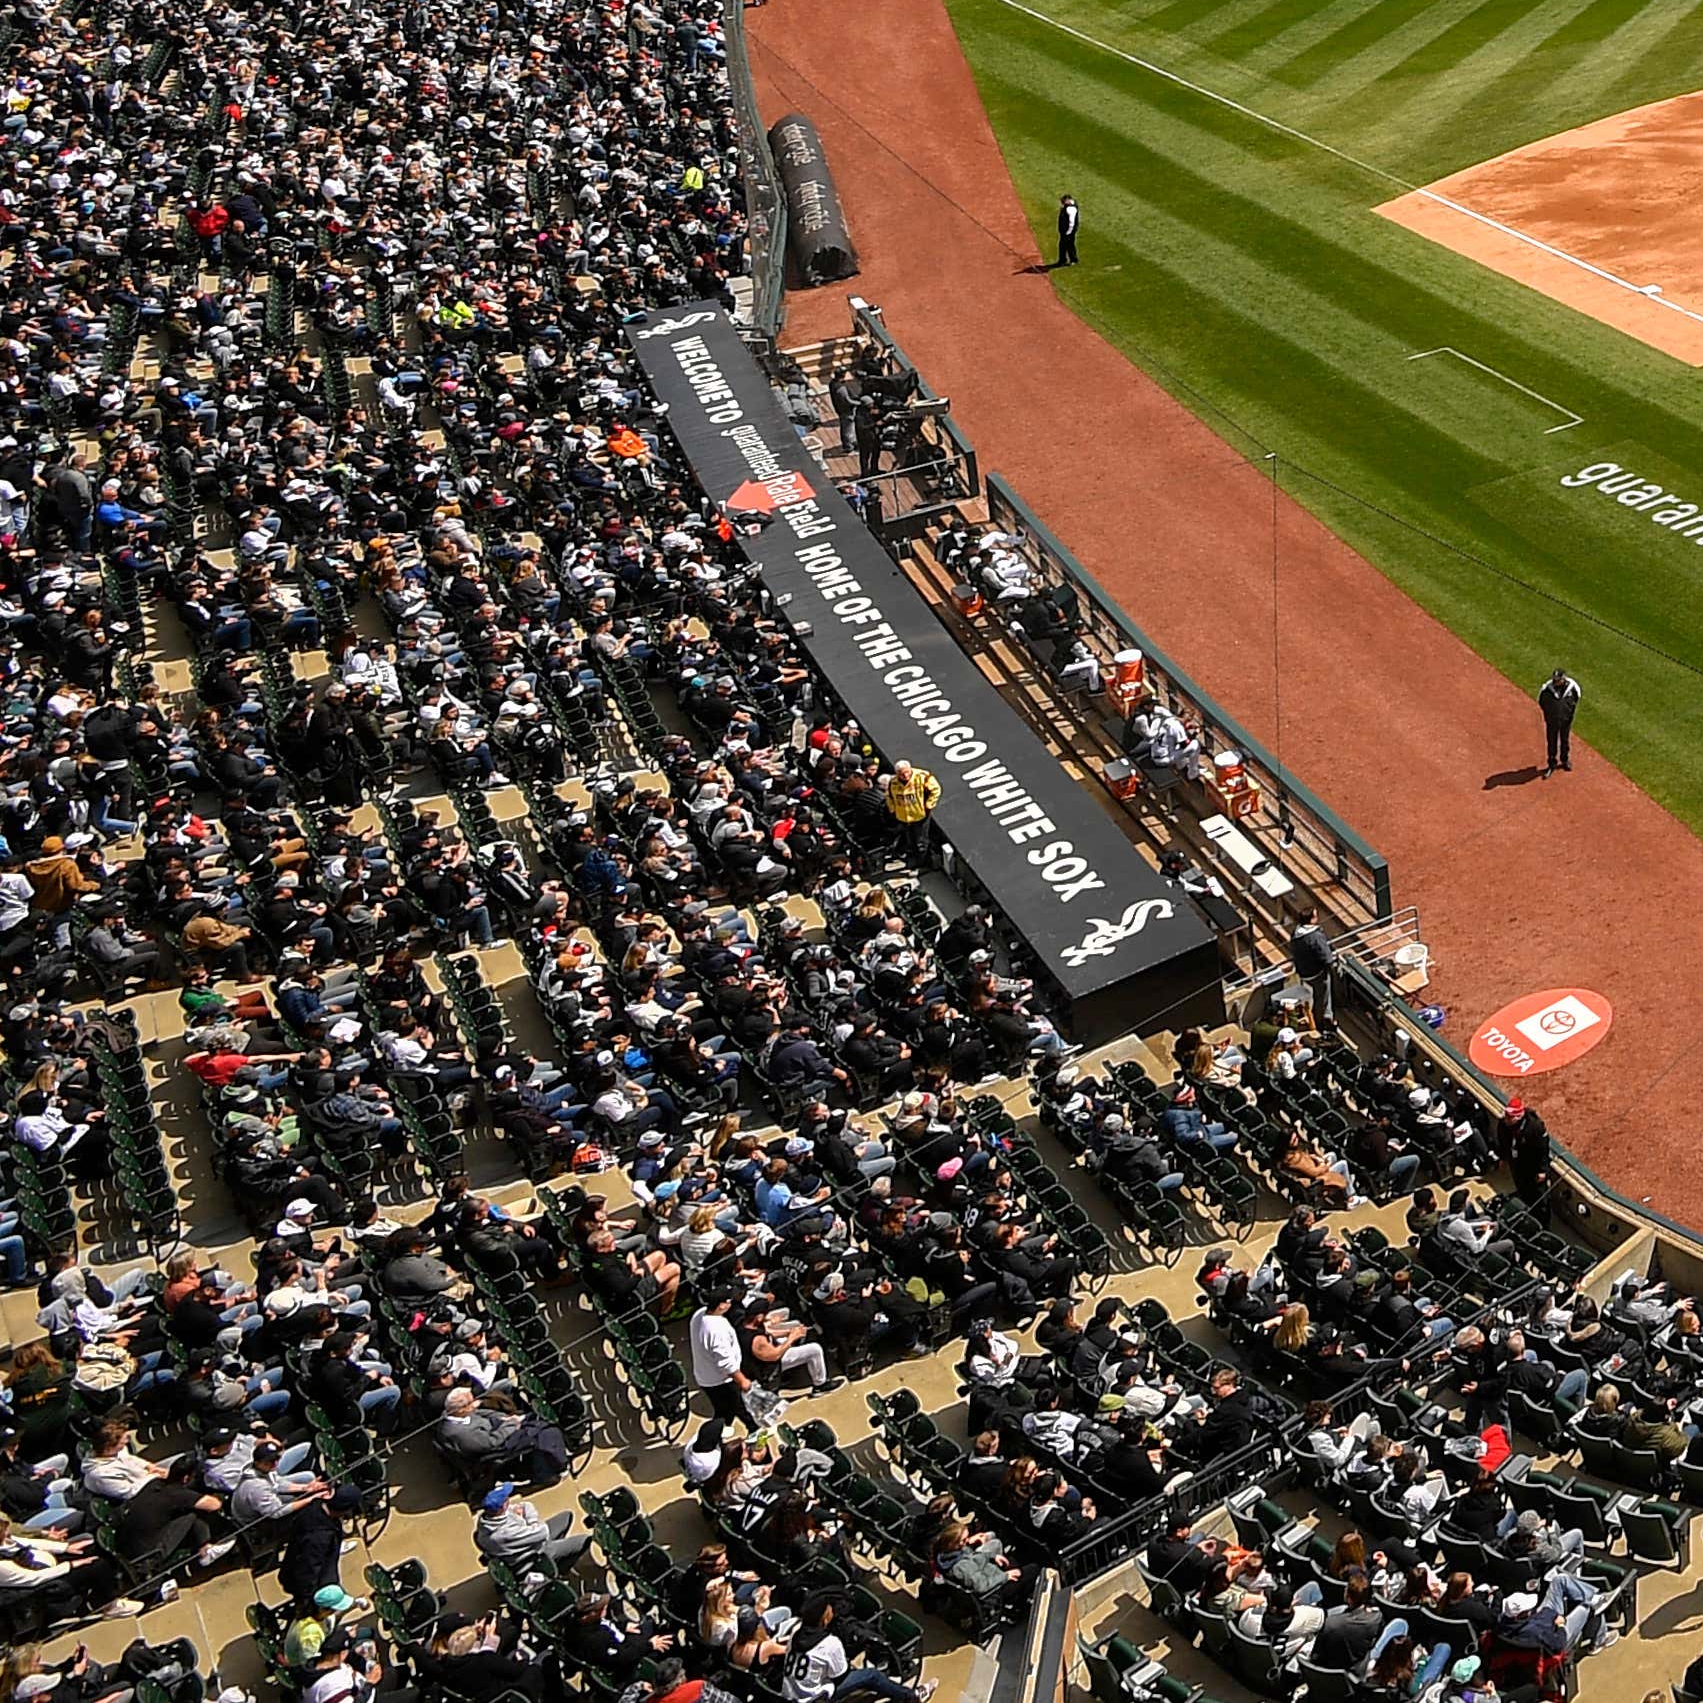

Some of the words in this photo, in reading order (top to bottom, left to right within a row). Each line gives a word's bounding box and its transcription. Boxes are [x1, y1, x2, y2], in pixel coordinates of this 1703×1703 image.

[670, 335, 734, 404] WELCOME
[705, 395, 744, 425] TO
[778, 498, 837, 540] Field
[794, 541, 861, 605] HOME
[833, 594, 879, 638] OF
[851, 618, 915, 671] THE
[883, 659, 989, 766] CHICAGO
[961, 758, 1056, 848] WHITE
[1026, 838, 1109, 903] SOX
[1480, 1026, 1535, 1073] TOYOTA
